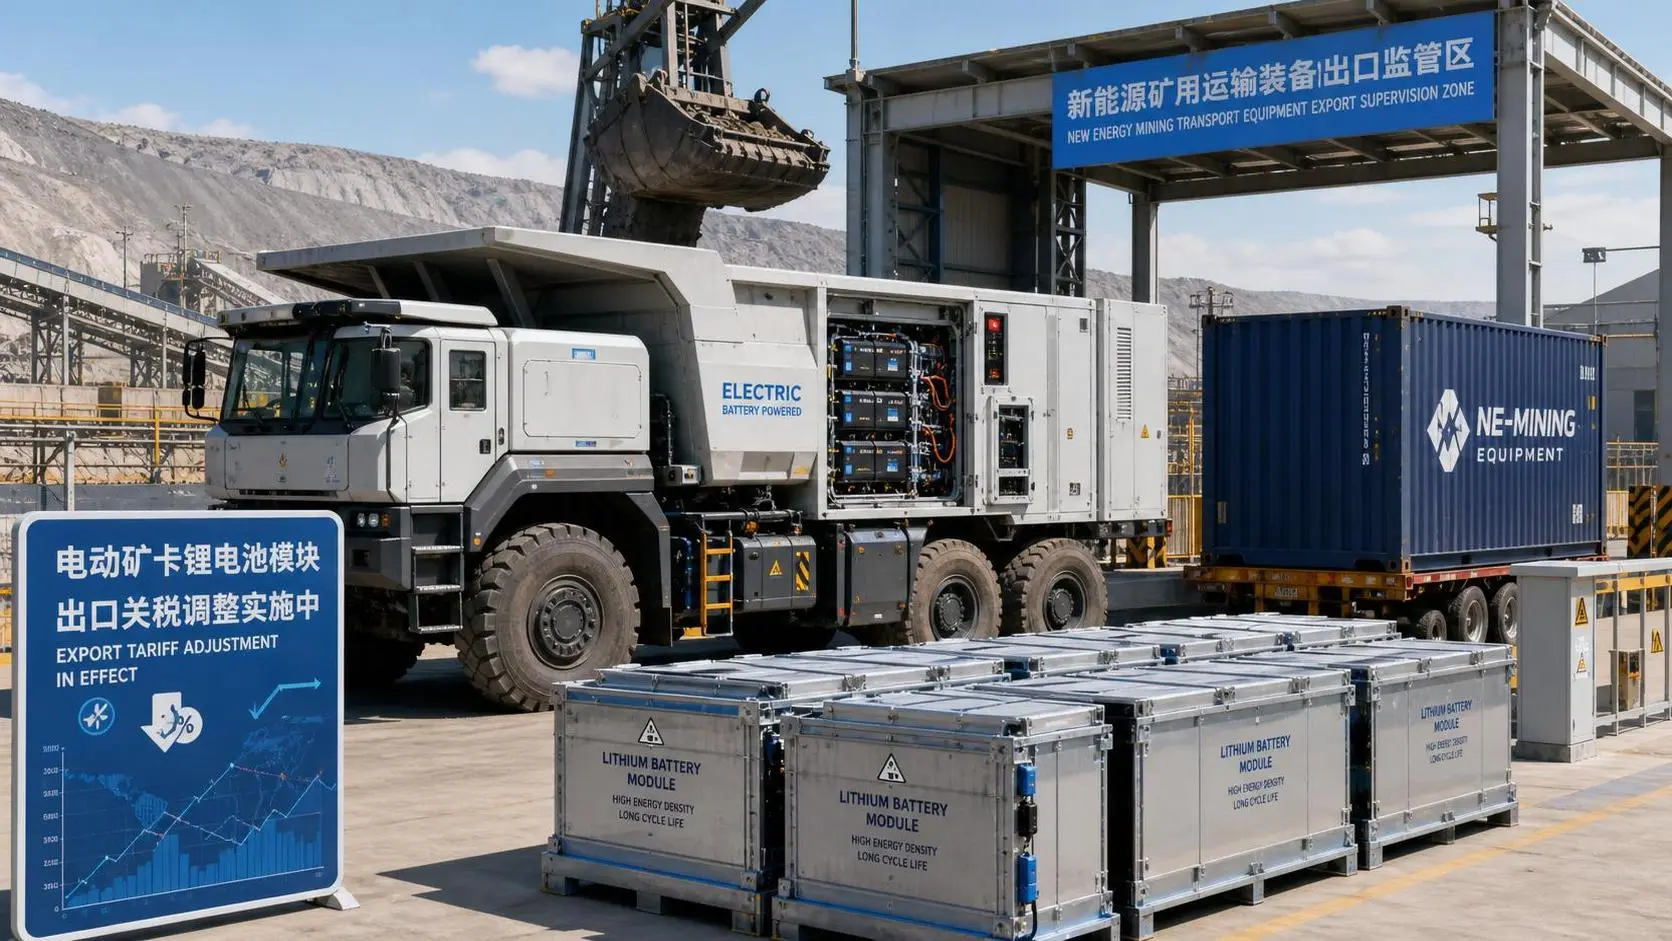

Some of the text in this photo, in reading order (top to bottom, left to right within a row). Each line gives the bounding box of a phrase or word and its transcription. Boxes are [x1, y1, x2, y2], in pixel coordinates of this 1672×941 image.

[1067, 80, 1475, 144] NEW ENERGY MINING TRANSPORT EQUIPMENT EXPORT SUPERVISION ZONE
[722, 382, 802, 401] ELECTRIC
[722, 405, 802, 416] BATTERY POWERED
[1476, 406, 1576, 438] NE-MINING
[1476, 447, 1564, 464] EQUIPMENT
[56, 541, 321, 580] 电动矿卡锂电池模块
[56, 588, 320, 633] 出口关税调整实施中
[56, 634, 279, 664] EXPORT TARIFF ADJUSTMENT
[56, 666, 138, 688] IN EFFECT
[1220, 734, 1291, 758] LITHIUM BATTERY
[602, 751, 701, 775] LITHIUM BATTERY
[1239, 756, 1273, 773] MODULE
[627, 772, 676, 791] MODULE
[612, 794, 695, 815] HIGH ENERGY DENSITY
[839, 790, 948, 817] LITHIUM BATTERY
[619, 810, 684, 828] LONG CYCLE LIFE
[866, 812, 919, 833] MODULE
[851, 834, 938, 856] HIGH ENERGY DENSITY
[857, 850, 928, 871] LONG CYCLE LIFE
